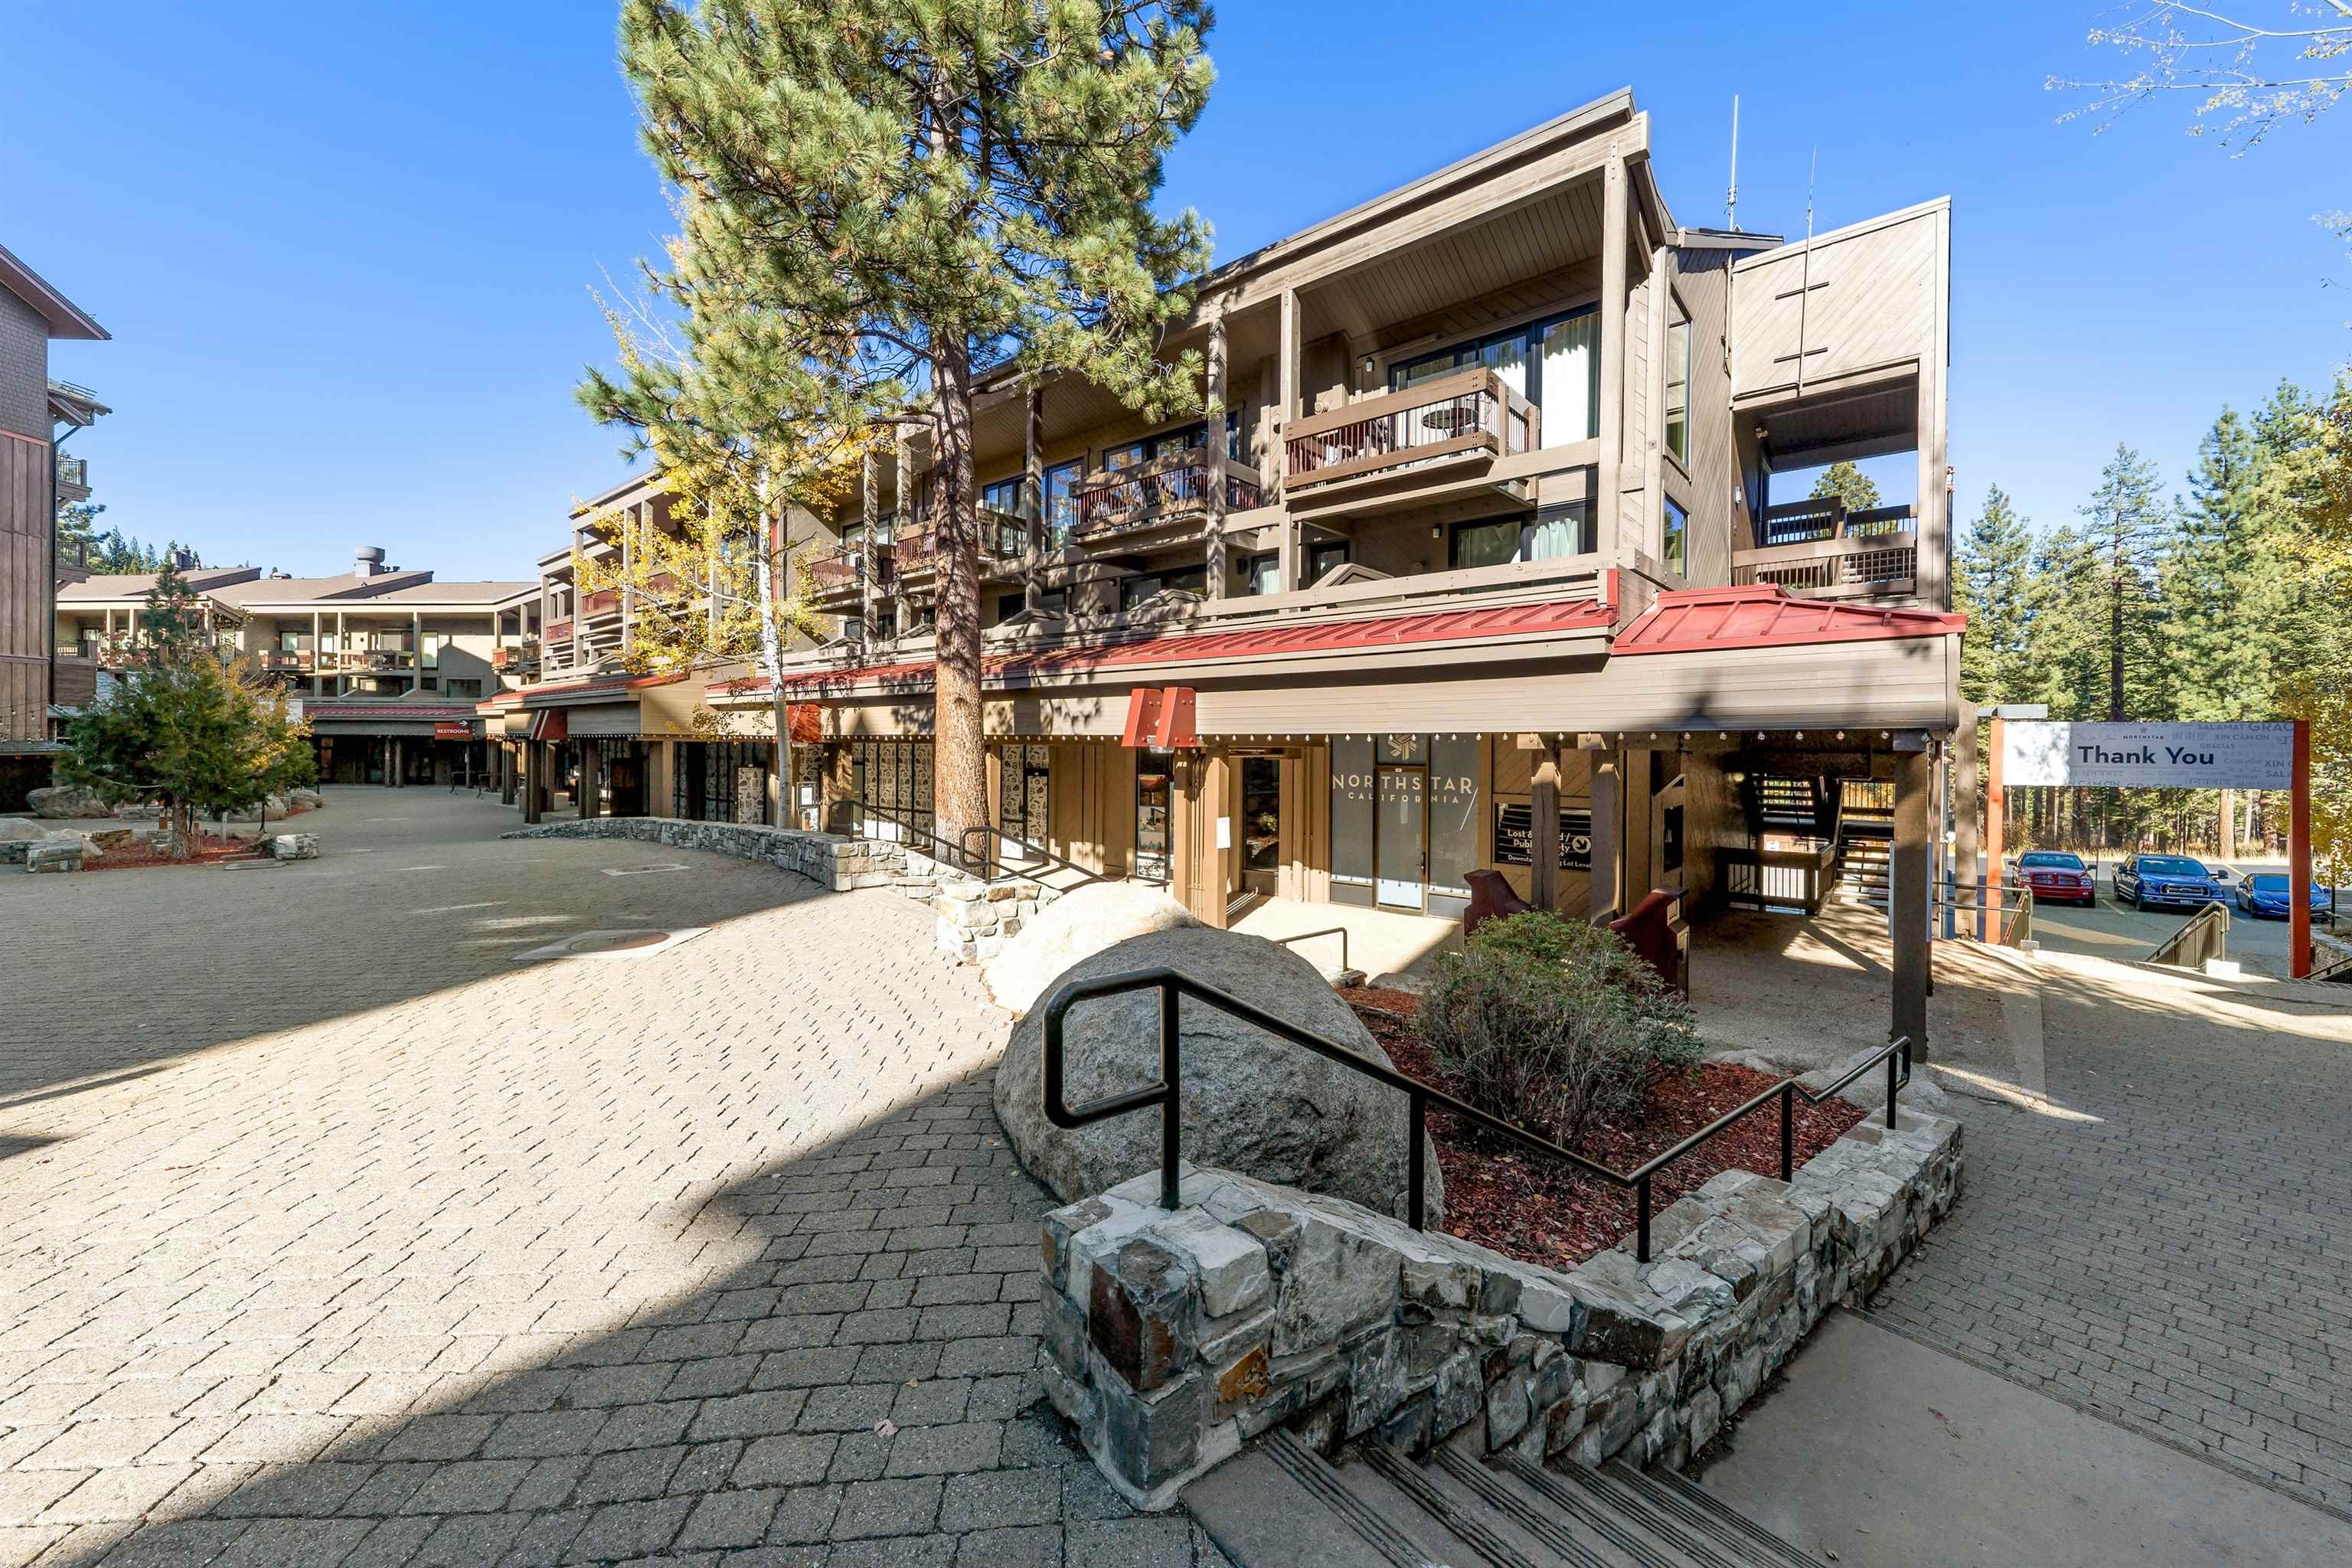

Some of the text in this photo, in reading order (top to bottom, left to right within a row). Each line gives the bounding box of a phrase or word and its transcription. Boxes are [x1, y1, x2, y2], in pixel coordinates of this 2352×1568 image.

[2077, 745, 2214, 765] Thank You
[1332, 774, 1472, 794] NORTHSTAR
[1348, 792, 1459, 803] CALIFORNIA
[1508, 828, 1526, 838] Lost
[1514, 839, 1532, 848] Publ
[1508, 854, 1532, 863] Downsta
